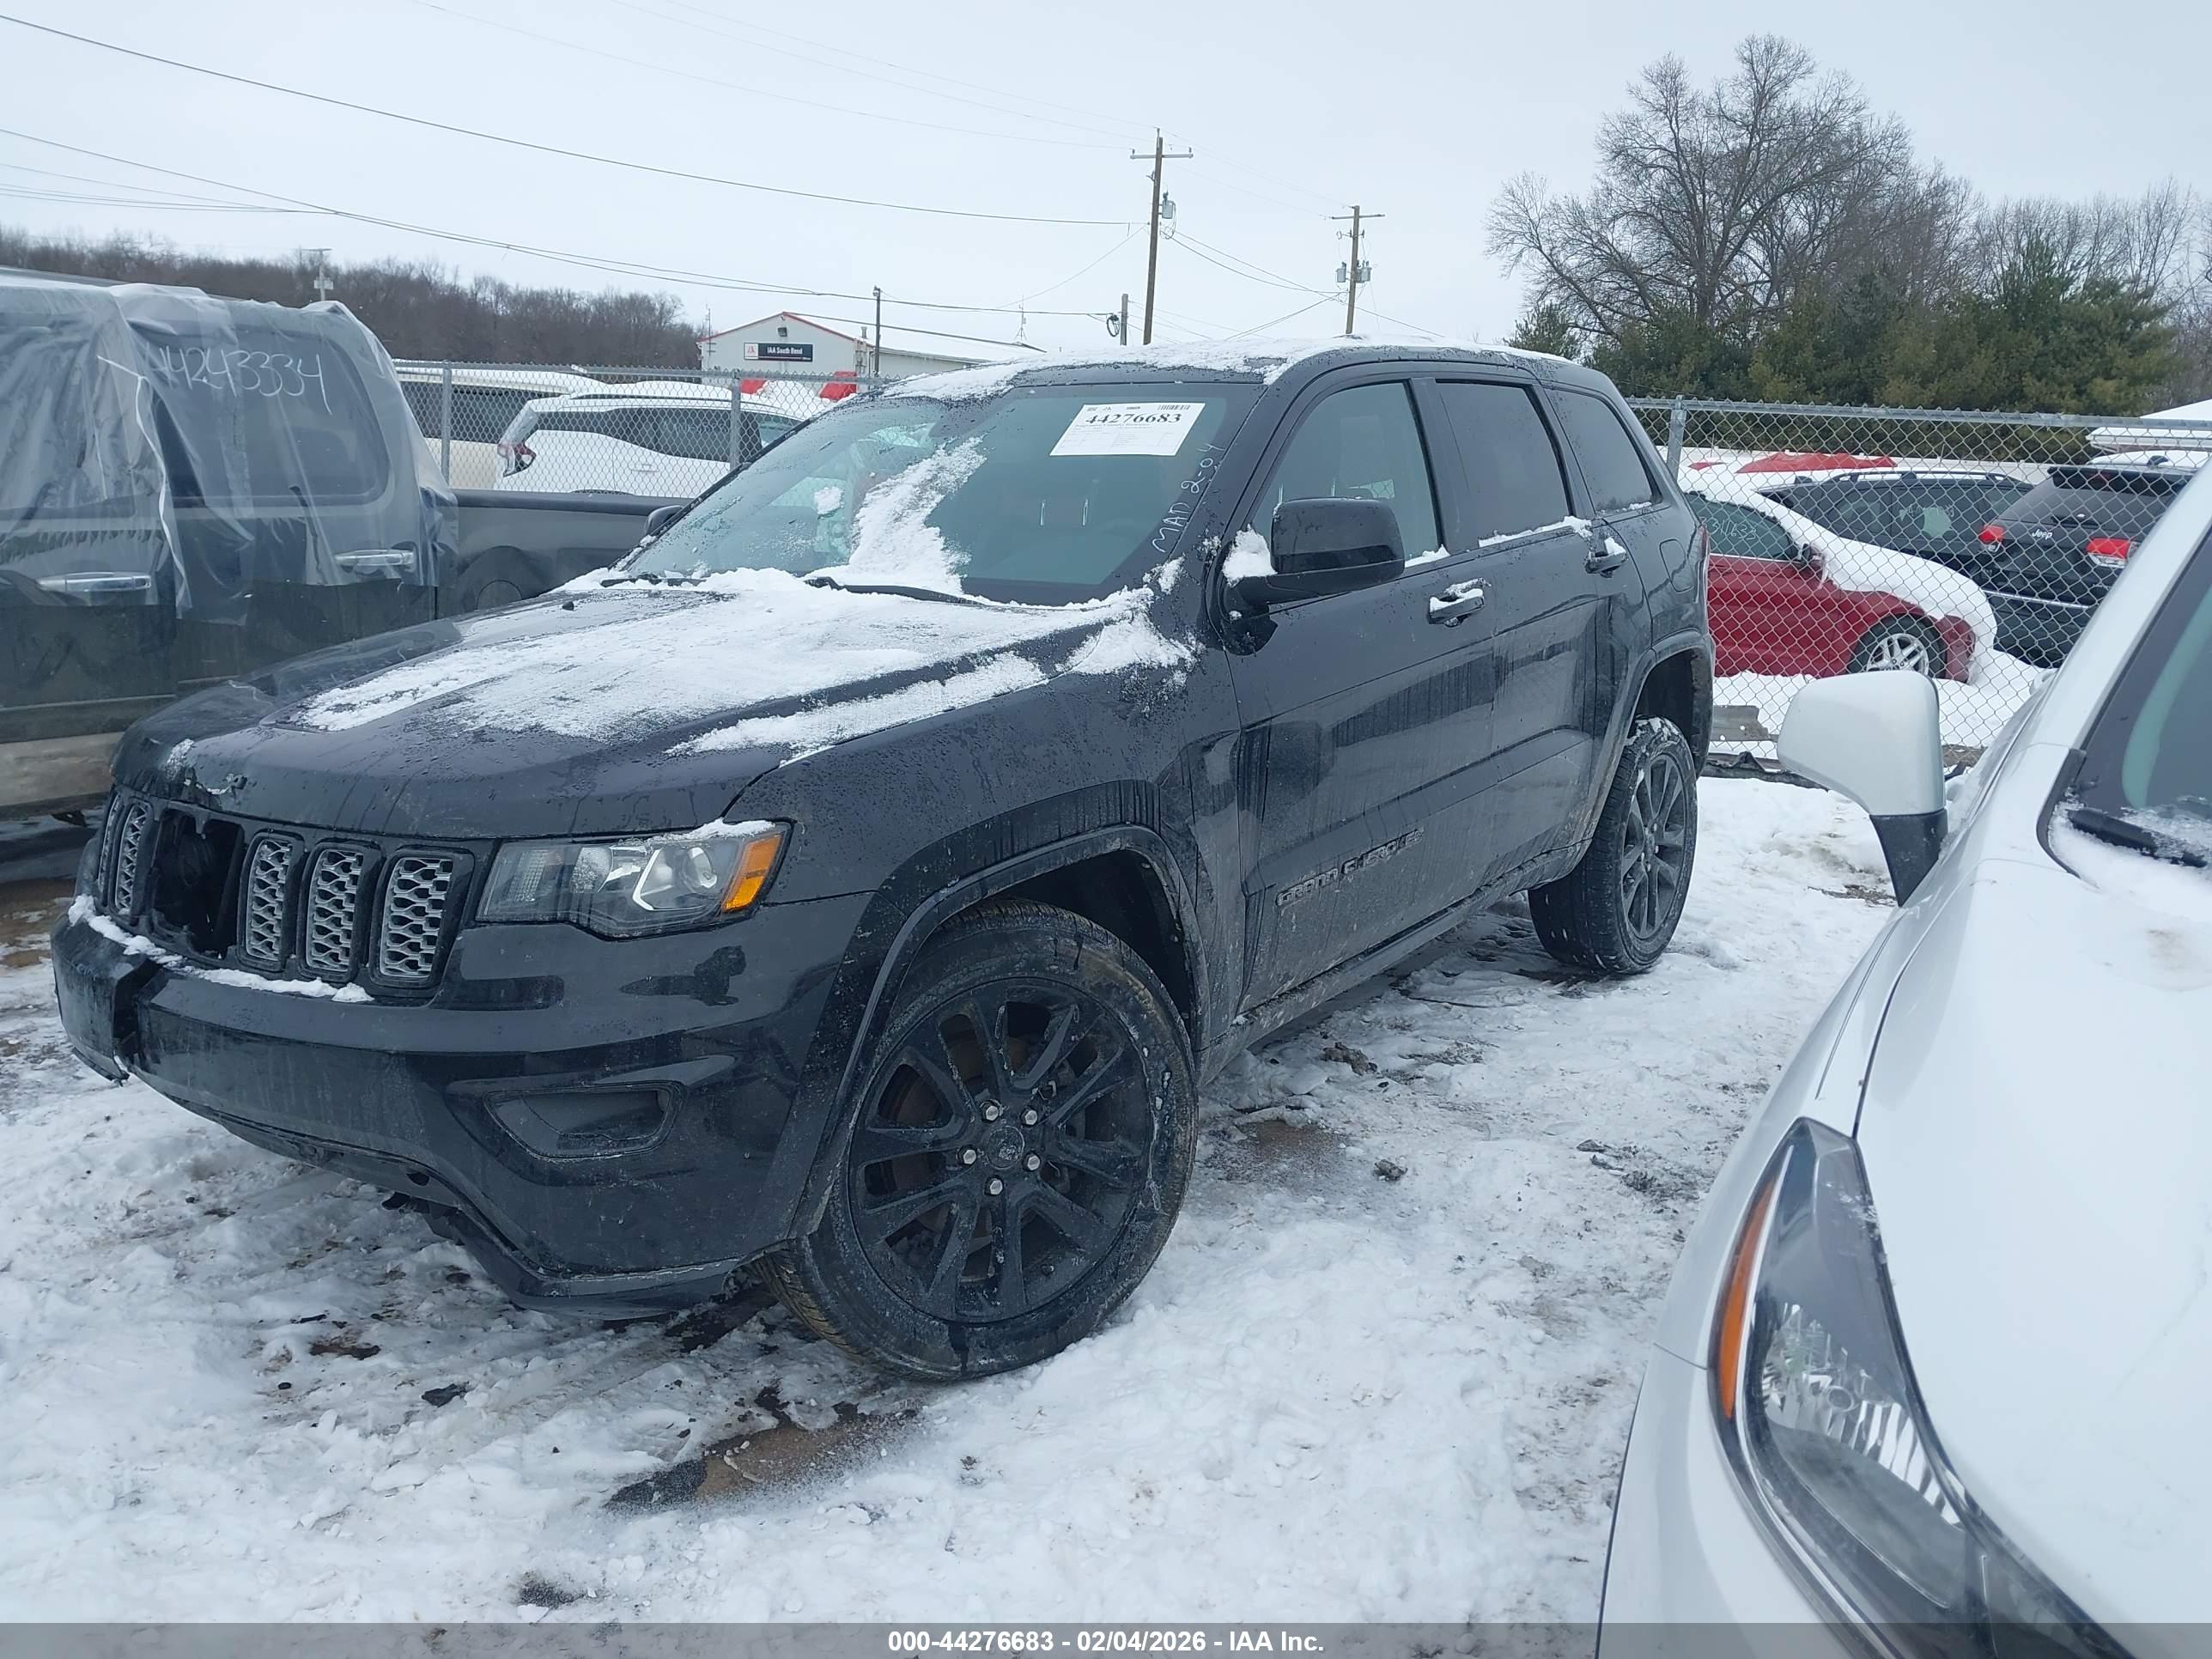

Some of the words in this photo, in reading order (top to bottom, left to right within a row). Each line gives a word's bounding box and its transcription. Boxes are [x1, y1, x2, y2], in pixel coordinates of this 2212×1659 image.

[776, 346, 790, 355] South
[1085, 412, 1182, 424] 44276683
[1152, 502, 1190, 553] MAD
[2032, 528, 2053, 540] Jeep
